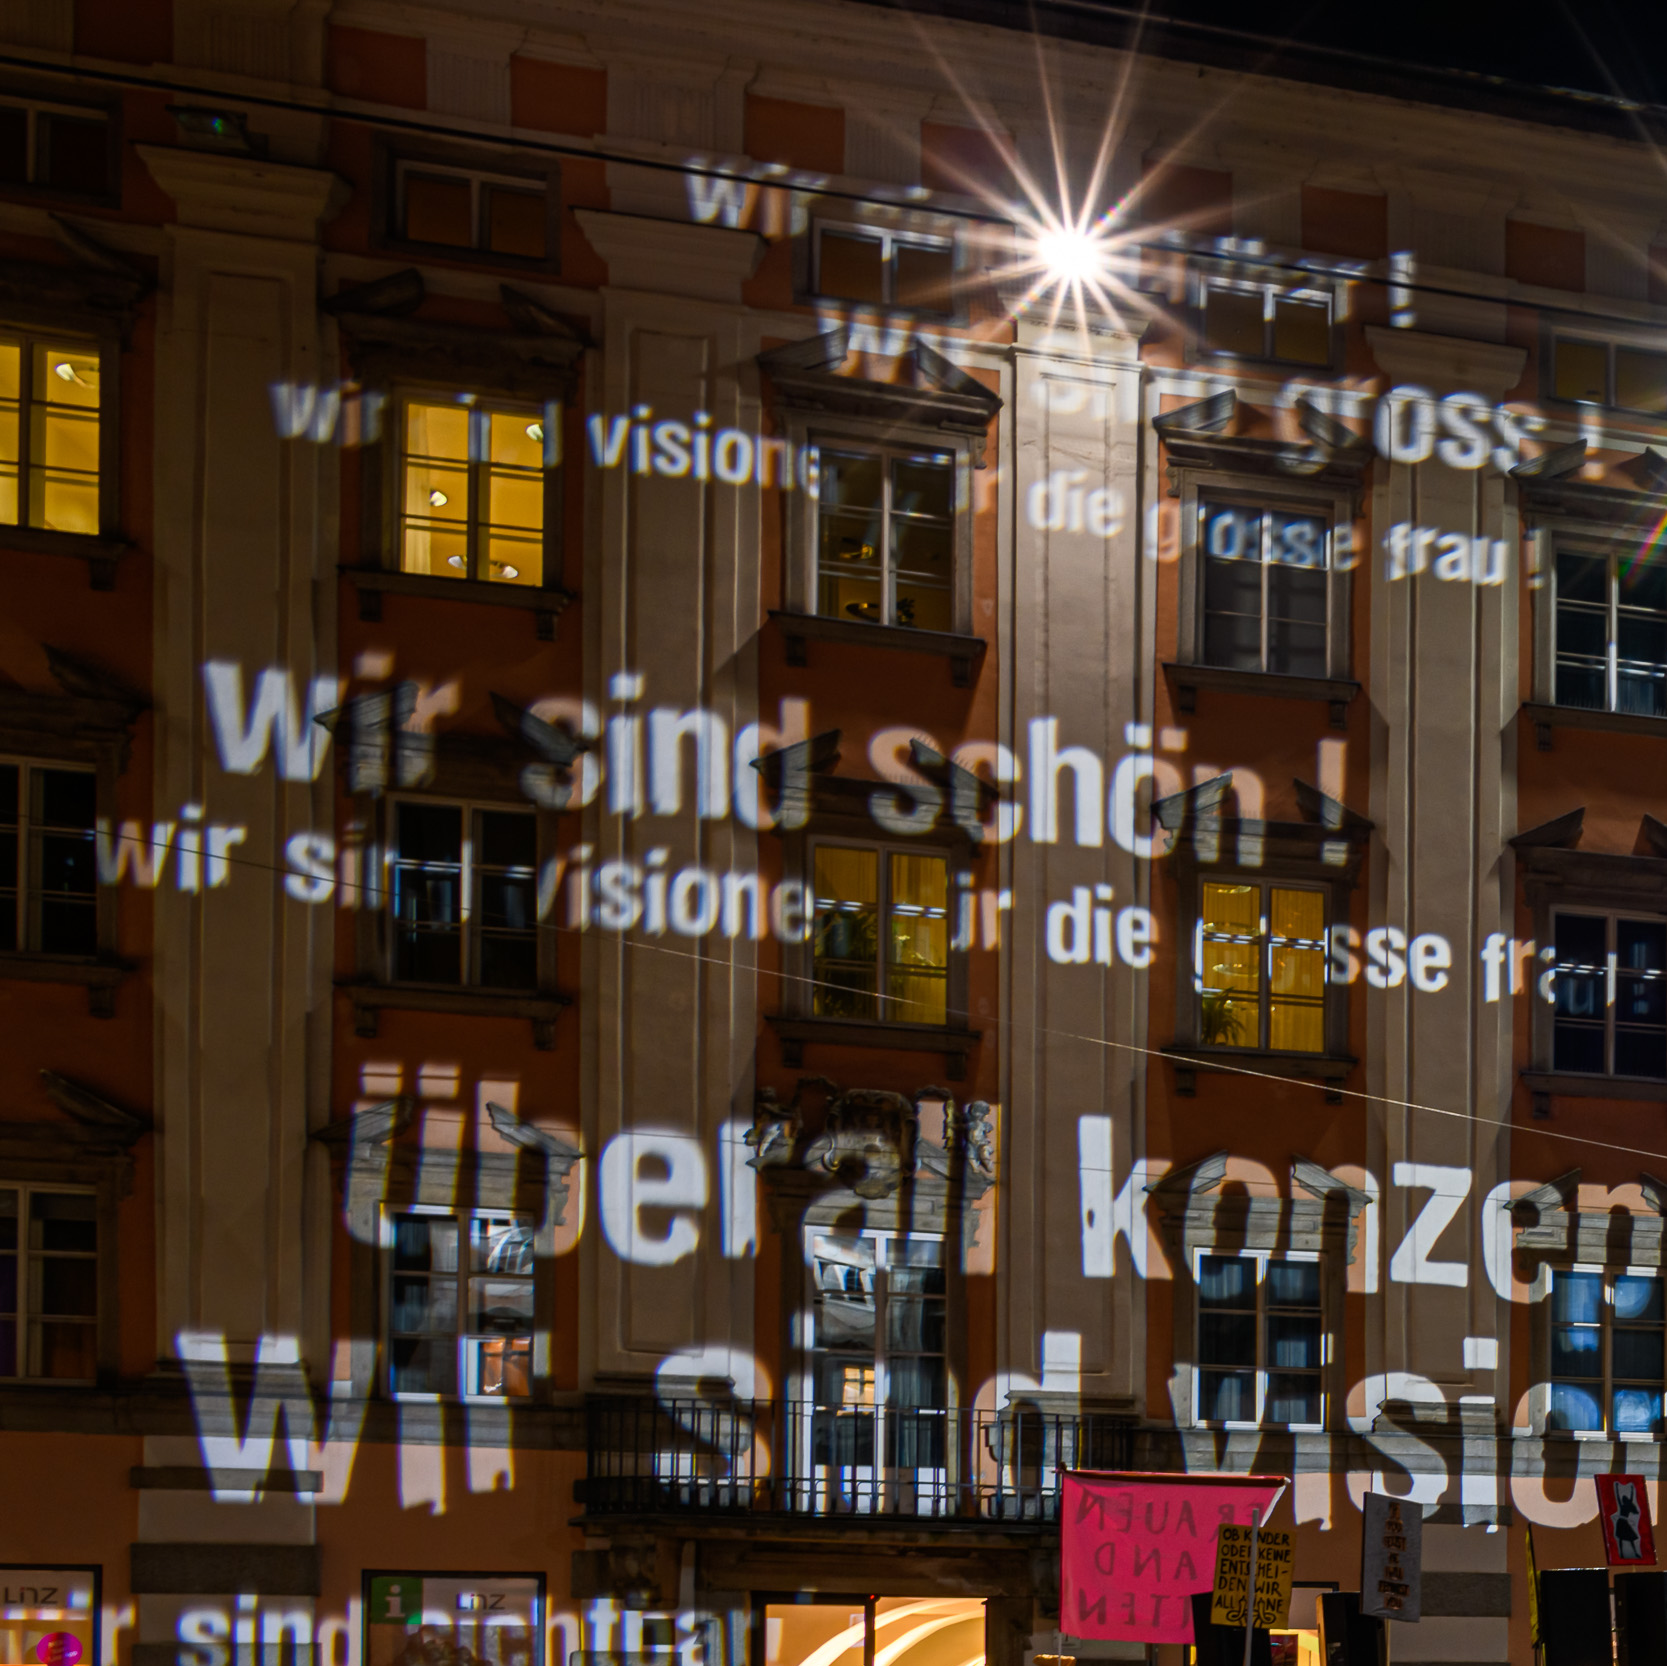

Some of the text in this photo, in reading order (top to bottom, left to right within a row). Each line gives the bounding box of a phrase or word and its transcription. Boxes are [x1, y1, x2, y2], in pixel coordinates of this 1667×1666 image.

[1027, 468, 1128, 538] die
[1384, 520, 1509, 588] frau
[520, 672, 813, 832] sind
[868, 715, 1268, 868] schön
[1046, 884, 1158, 969] die
[1222, 1527, 1291, 1547] OB KNDER
[1218, 1576, 1283, 1597] DEN WIR
